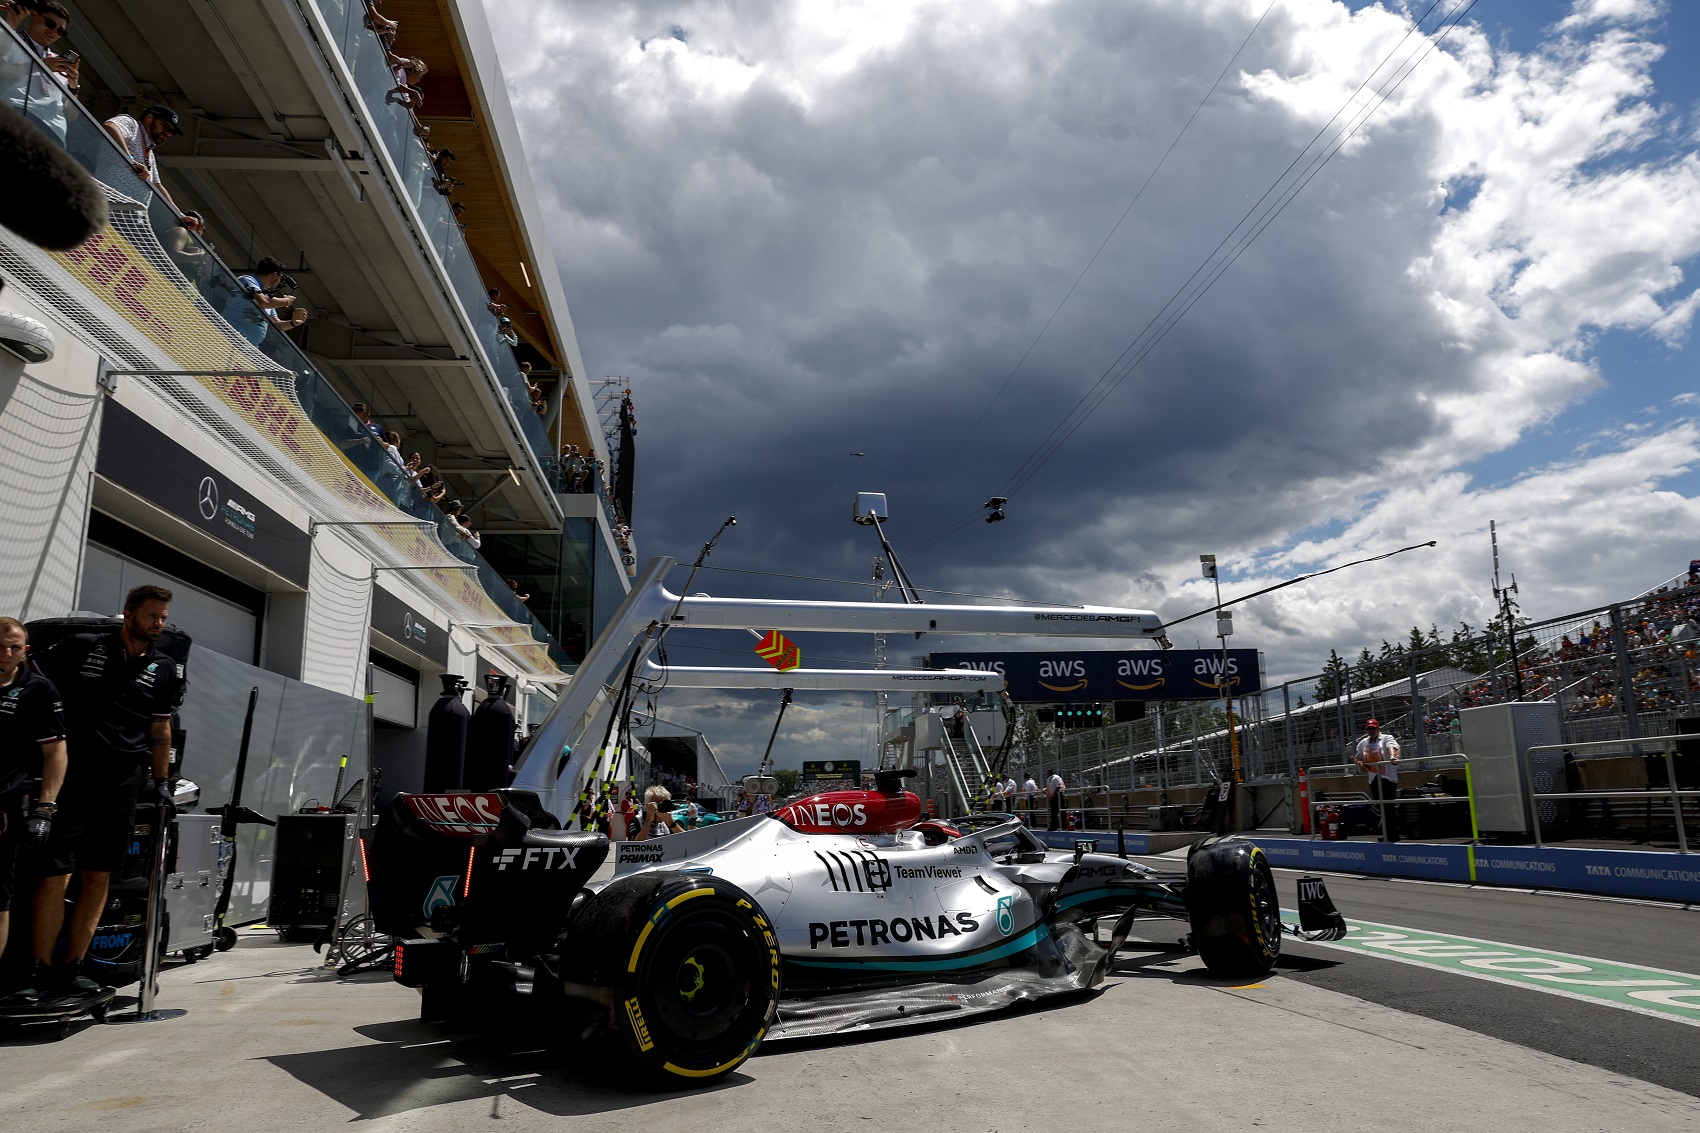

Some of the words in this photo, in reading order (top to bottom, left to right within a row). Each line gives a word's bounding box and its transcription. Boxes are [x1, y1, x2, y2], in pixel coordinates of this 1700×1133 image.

[774, 645, 795, 668] BRAKES
[1039, 660, 1086, 677] aws
[1117, 659, 1163, 676] aws
[1194, 657, 1238, 675] aws
[412, 796, 501, 833] INEOS
[789, 803, 867, 826] INEOS
[522, 847, 581, 870] FTX
[619, 852, 665, 864] PRIMAX
[953, 847, 972, 855] AMD
[1312, 850, 1325, 858] TATA
[1326, 851, 1365, 861] COMMUNICATIONS
[1382, 854, 1397, 863] TATA
[1399, 855, 1448, 866] COMMUNICATIONS
[1474, 858, 1489, 868] ATA
[1491, 859, 1556, 872] COMMUNICATIONS
[894, 865, 962, 879] TeamViewer
[1078, 864, 1116, 879] AMG
[1585, 864, 1612, 876] TATA
[1614, 866, 1700, 883] COMMUNICATIONS
[1300, 881, 1325, 900] IWC
[809, 913, 980, 949] PETRONAS
[93, 933, 132, 950] FRONT
[736, 898, 752, 909] P
[752, 913, 779, 990] ZERO
[625, 997, 654, 1052] PIRELLI
